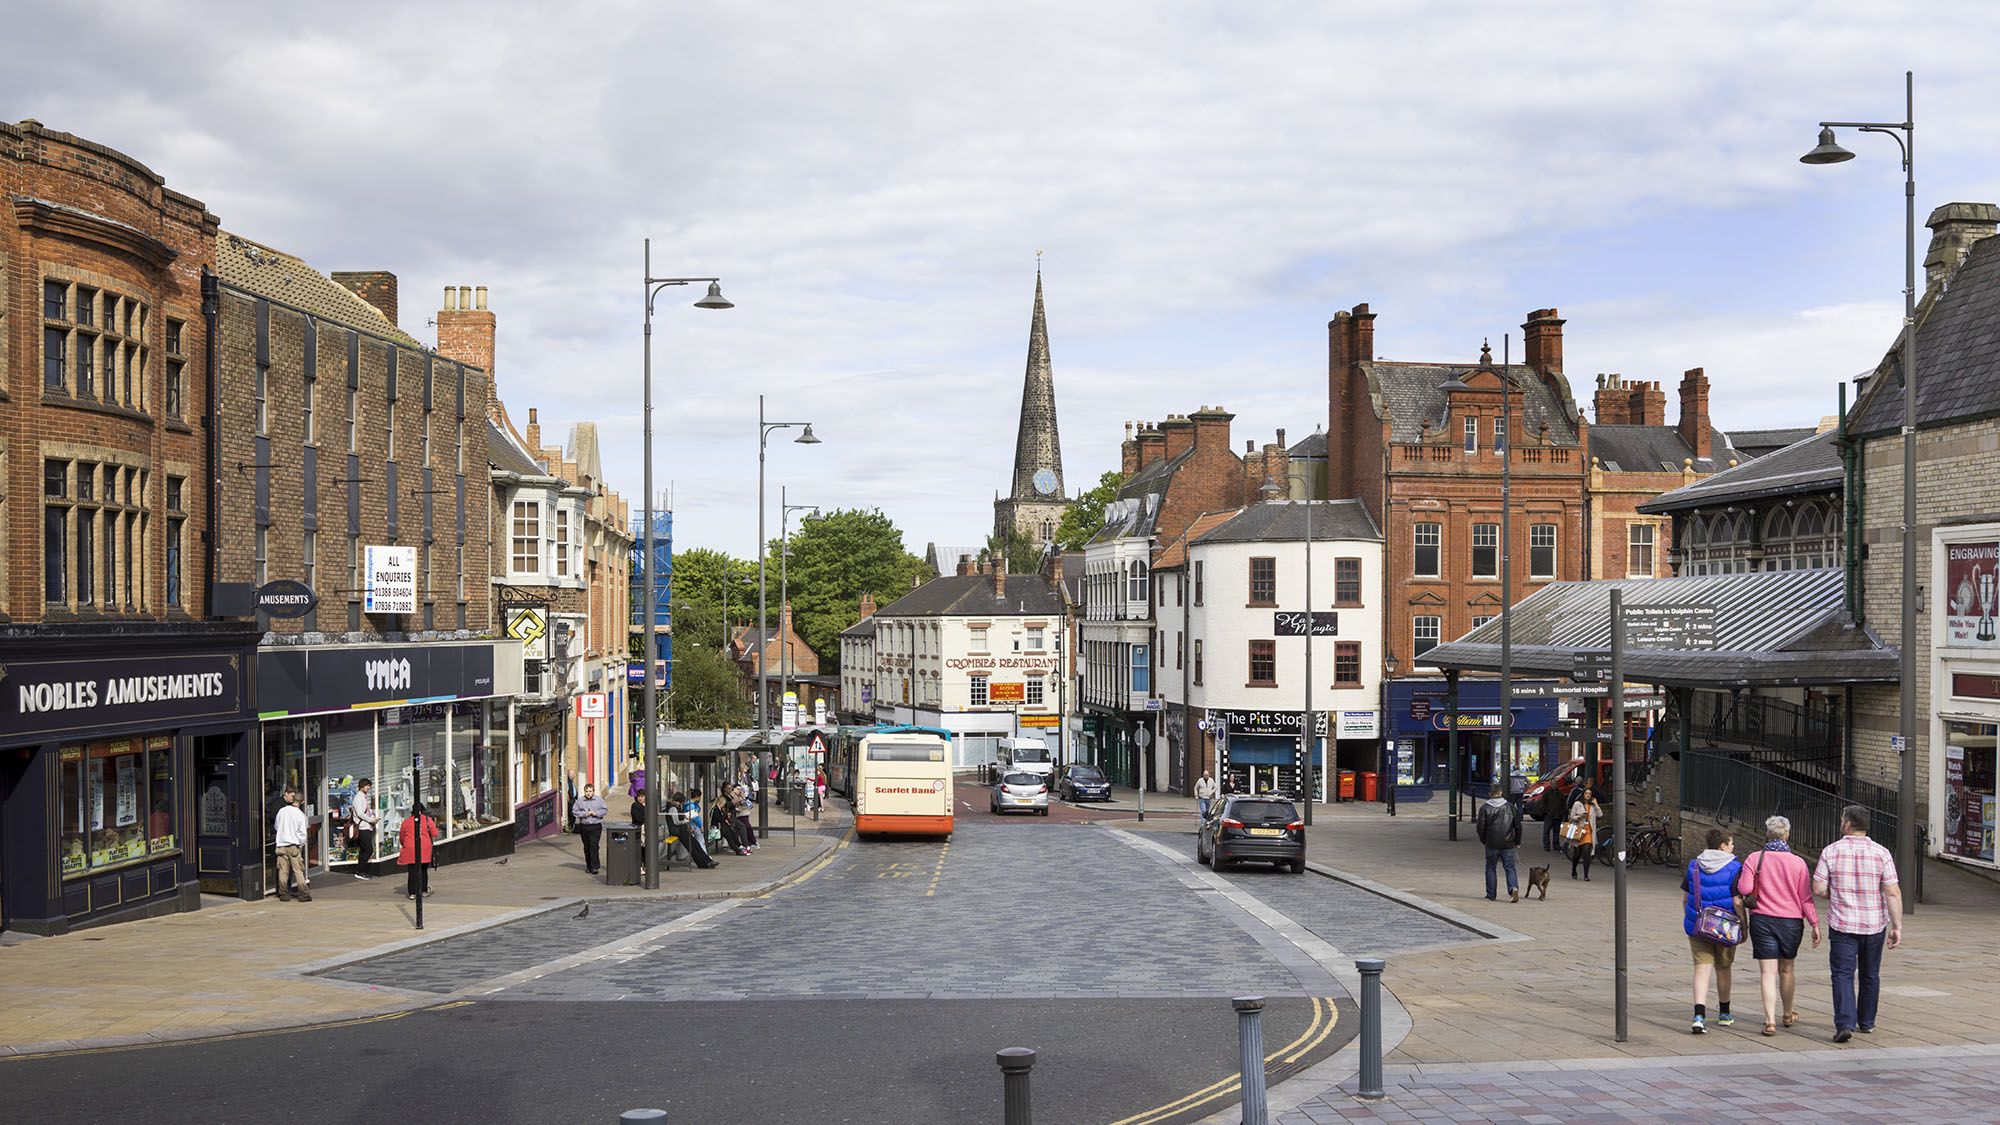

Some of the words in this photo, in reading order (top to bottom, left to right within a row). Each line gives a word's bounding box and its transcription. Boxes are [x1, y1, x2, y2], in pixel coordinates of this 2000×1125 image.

[1950, 546, 1999, 560] ENGRAVING
[388, 556, 400, 567] ALL
[376, 571, 412, 585] ENQUIRIES
[259, 594, 309, 605] AMUSEMENTS
[1671, 607, 1693, 615] Dolphin
[1276, 613, 1316, 627] Har
[1949, 619, 1964, 629] While
[1965, 619, 1975, 629] You
[1954, 631, 1969, 639] Wait!
[946, 658, 997, 670] CROMBIES
[999, 658, 1059, 669] RESTAURANT
[365, 657, 411, 691] YMCA
[19, 680, 98, 713] NOBLES
[105, 672, 223, 706] AMUSEMENTS
[1553, 686, 1581, 694] Memorial
[1582, 685, 1608, 695] Hospital
[1225, 711, 1246, 725] The
[1249, 711, 1270, 725] Pitt
[1274, 712, 1303, 728] Stop
[1597, 731, 1612, 740] Library
[875, 786, 910, 794] Scarlet
